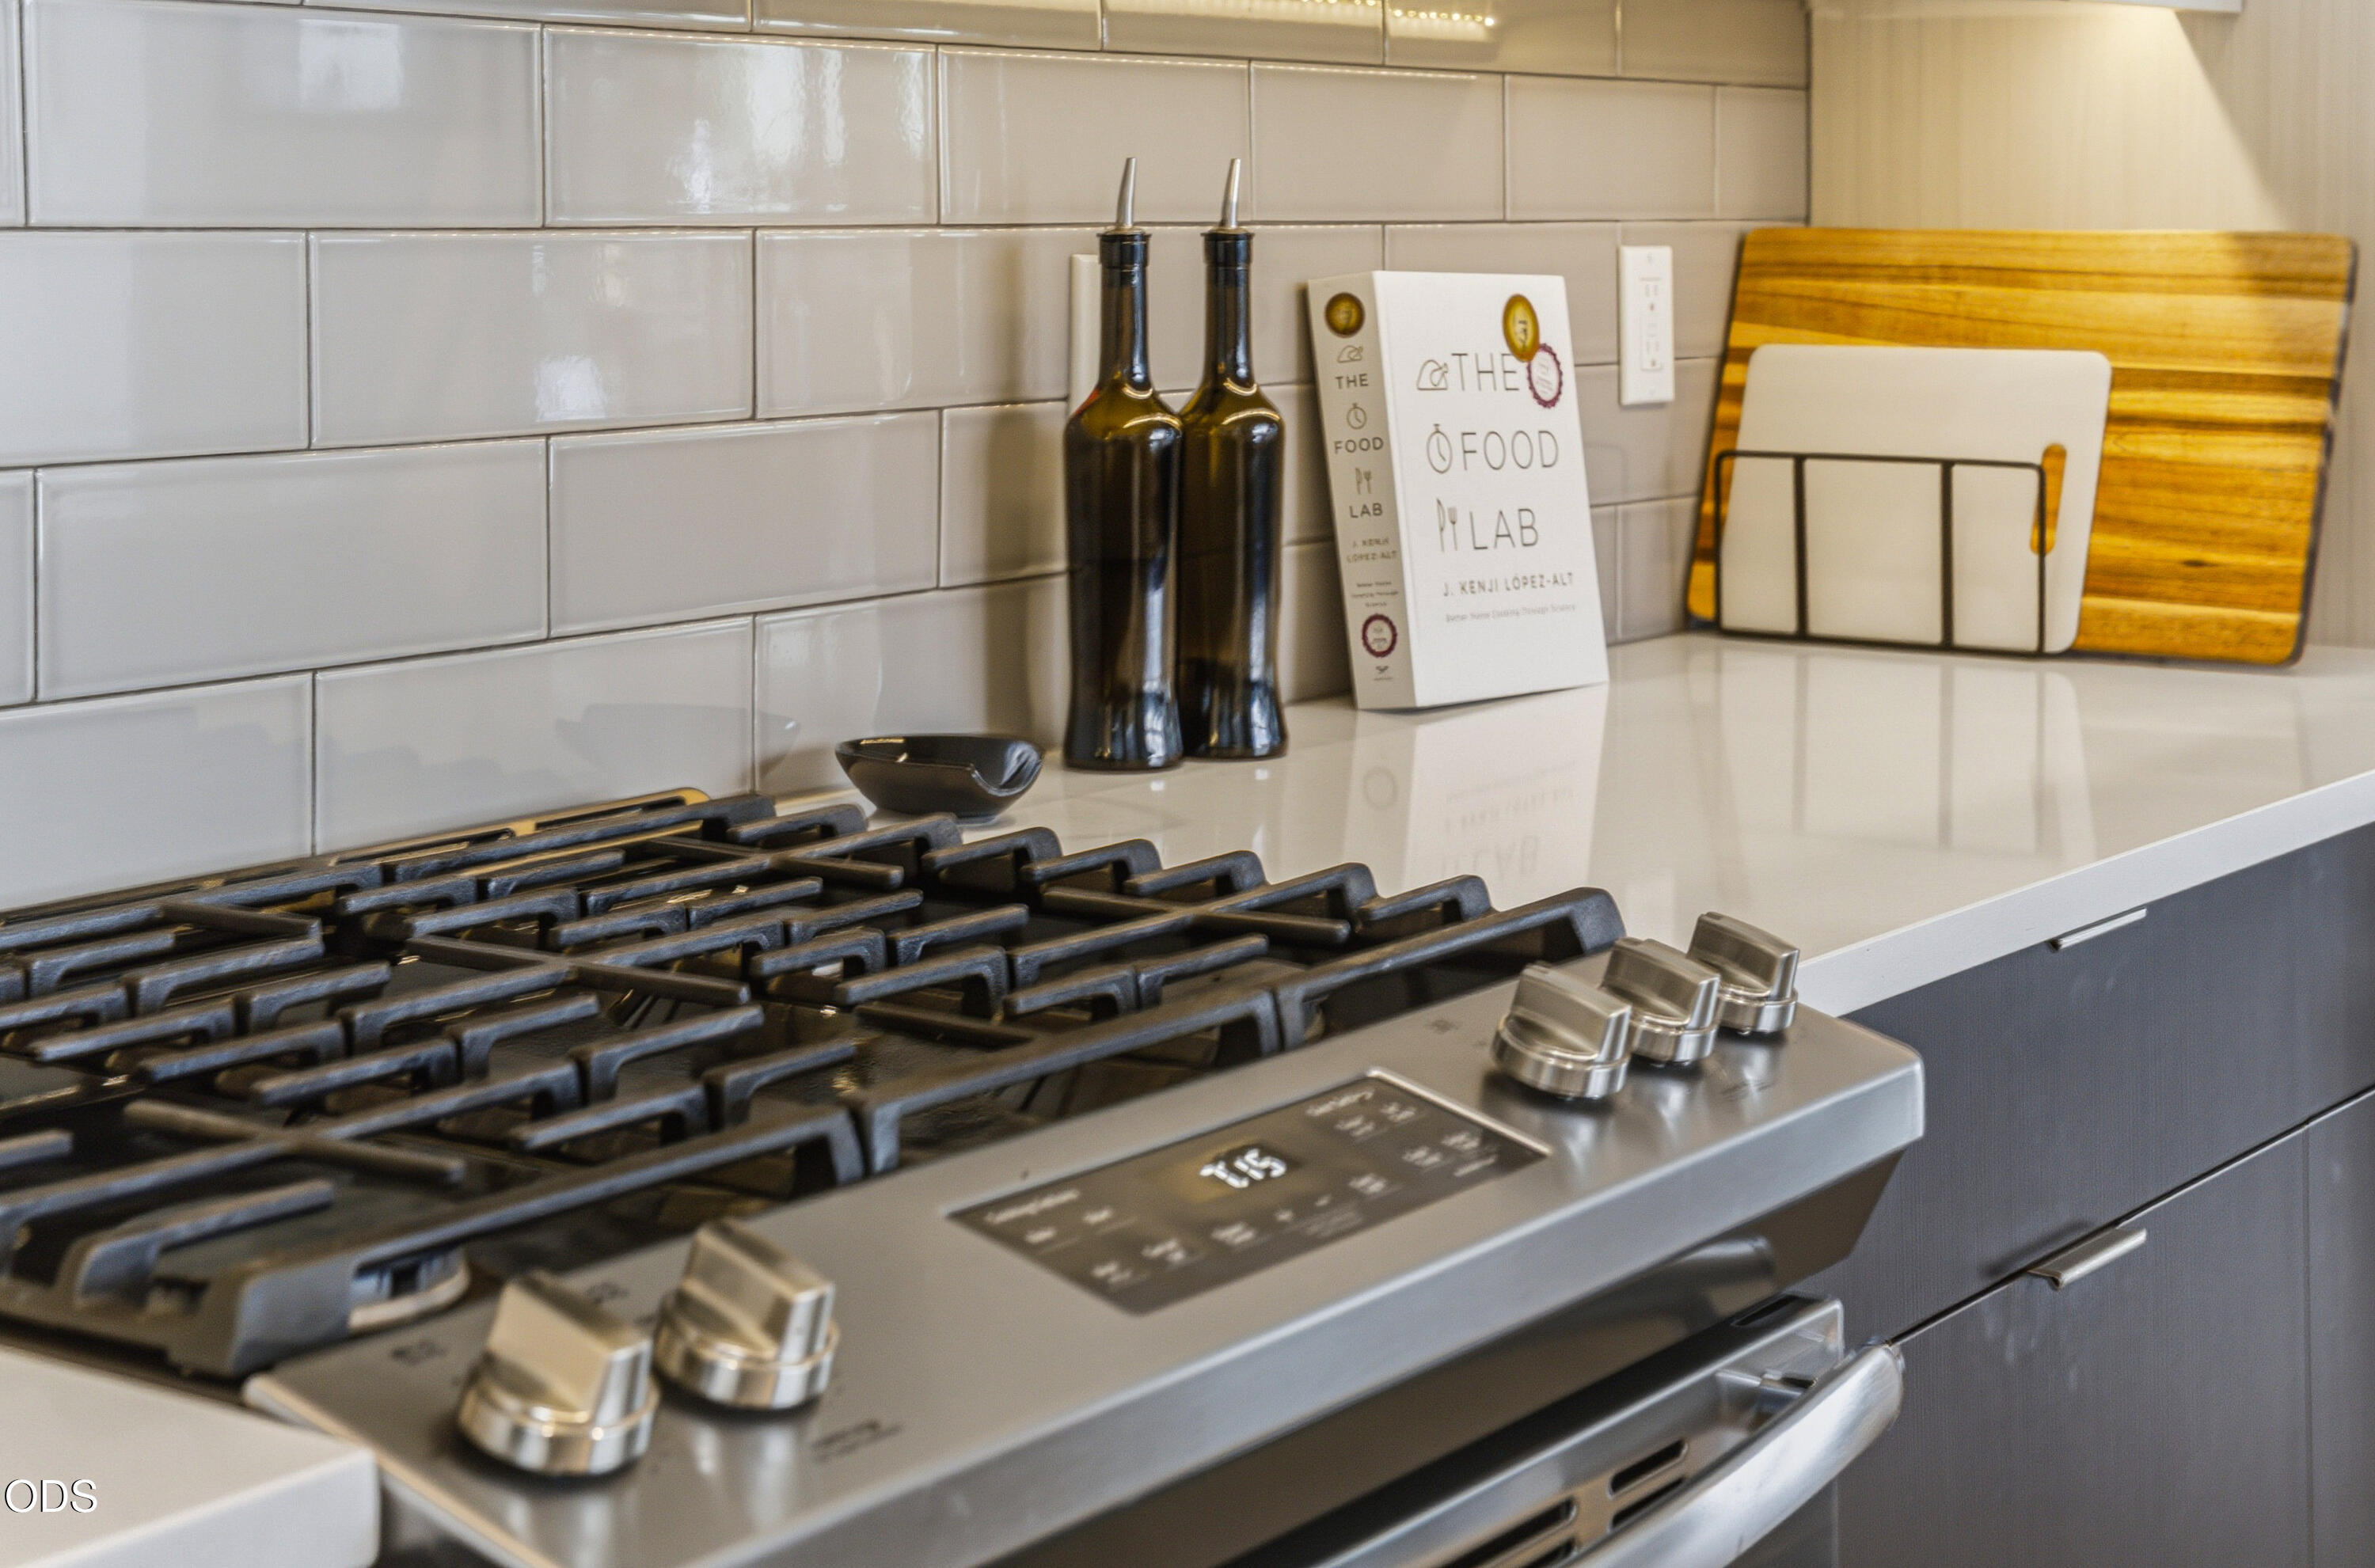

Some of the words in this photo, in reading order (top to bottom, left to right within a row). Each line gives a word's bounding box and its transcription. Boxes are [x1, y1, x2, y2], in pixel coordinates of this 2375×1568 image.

[1335, 373, 1369, 389] THE
[1451, 353, 1520, 392] THE
[1334, 437, 1384, 454] FOOD
[1461, 430, 1559, 471] FOOD
[1349, 503, 1384, 518] LAB
[1469, 508, 1539, 550] LAB
[1458, 578, 1499, 594] KENJI
